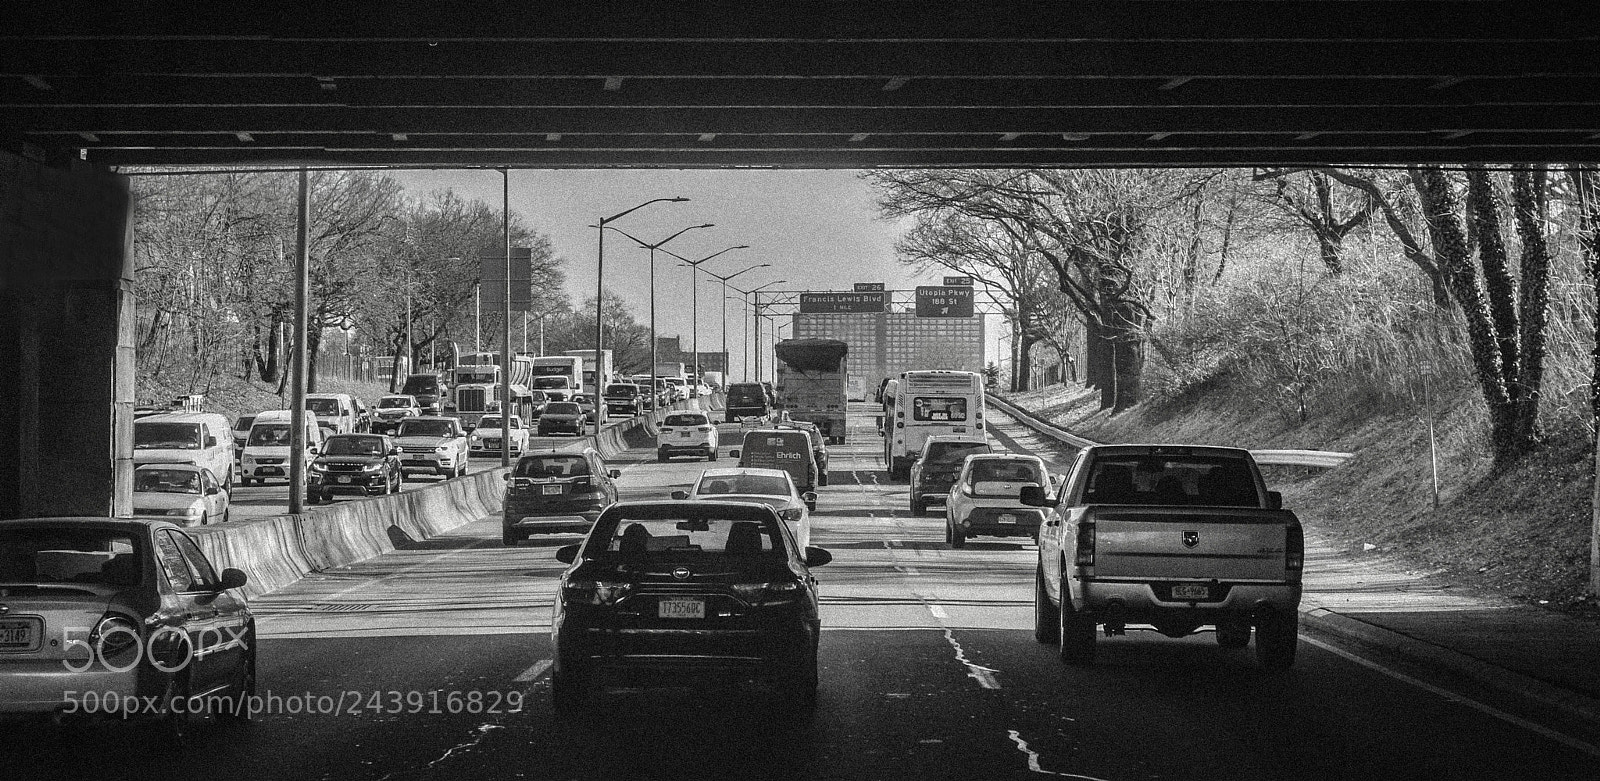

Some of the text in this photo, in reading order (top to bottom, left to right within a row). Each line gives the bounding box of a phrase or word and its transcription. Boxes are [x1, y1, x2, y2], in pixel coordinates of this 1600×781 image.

[919, 289, 970, 298] Utopia Pkwy
[803, 295, 882, 303] Francis Lewis Blvd
[776, 451, 801, 459] Ehrlich
